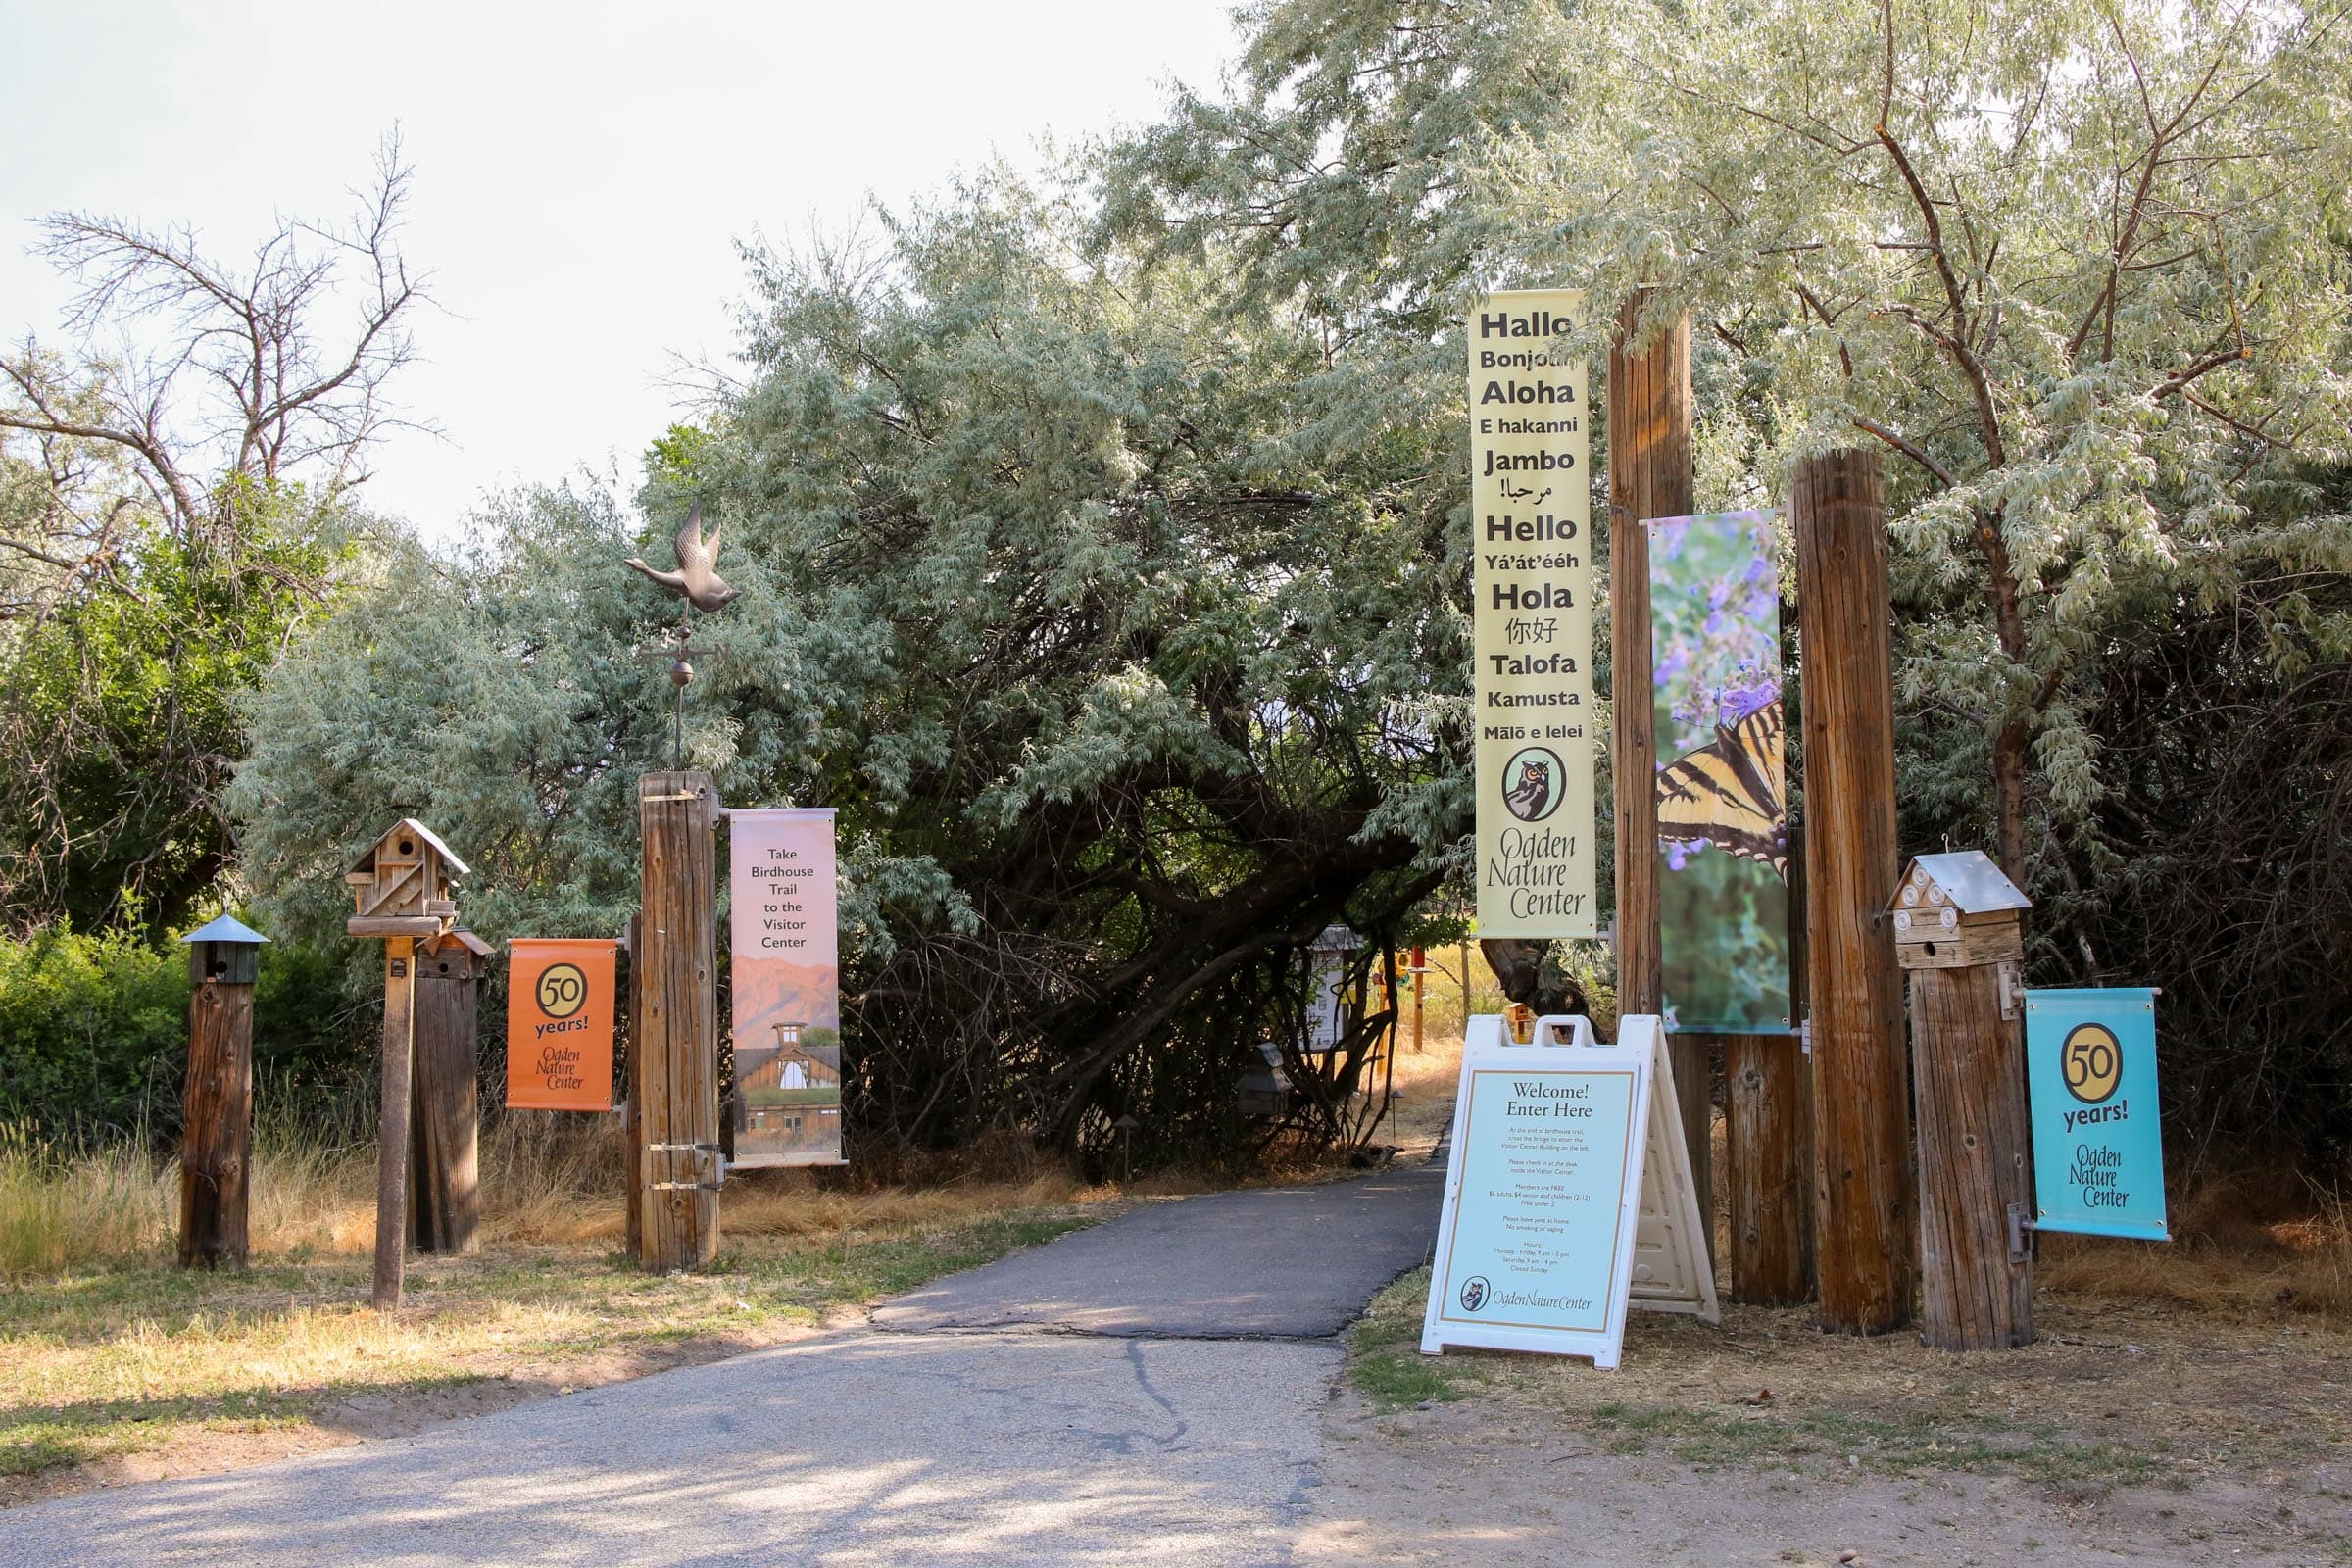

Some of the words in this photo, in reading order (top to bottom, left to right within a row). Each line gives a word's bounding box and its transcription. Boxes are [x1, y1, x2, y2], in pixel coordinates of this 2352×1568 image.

[1481, 312, 1572, 338] Hallo
[1481, 380, 1575, 405] Aloha
[1481, 419, 1492, 434] E
[1498, 417, 1578, 434] hakanni
[1483, 450, 1575, 477] Jambo
[1487, 515, 1578, 541] Hello
[1493, 583, 1574, 610] Hola
[1505, 617, 1558, 645] 你好
[1490, 653, 1577, 675] Talofa
[1488, 691, 1580, 707] Kamusta
[1484, 726, 1526, 740] Mālō
[1531, 728, 1541, 739] e
[1545, 725, 1583, 738] lelei
[767, 849, 798, 859] Take
[1500, 827, 1577, 866] Ogden
[752, 866, 814, 878] Birdhouse
[1487, 845, 1567, 887] Nature
[768, 884, 797, 895] Trail
[764, 904, 778, 912] to
[782, 902, 802, 912] the
[1510, 888, 1586, 919] Center
[763, 919, 806, 930] Visitor
[761, 937, 806, 948] Center
[543, 978, 580, 1007] 50
[535, 1016, 589, 1039] years!
[543, 1046, 580, 1064] Ogden
[2069, 1044, 2113, 1087] 50
[535, 1059, 575, 1075] Nature
[547, 1074, 584, 1090] Center
[1513, 1082, 1589, 1099] Welcome!
[1506, 1101, 1549, 1117] Enter
[1554, 1102, 1592, 1117] Here
[2063, 1100, 2129, 1133] years!
[2077, 1144, 2121, 1171] Ogden
[2069, 1156, 2117, 1187] Nature
[2083, 1186, 2129, 1208] Center
